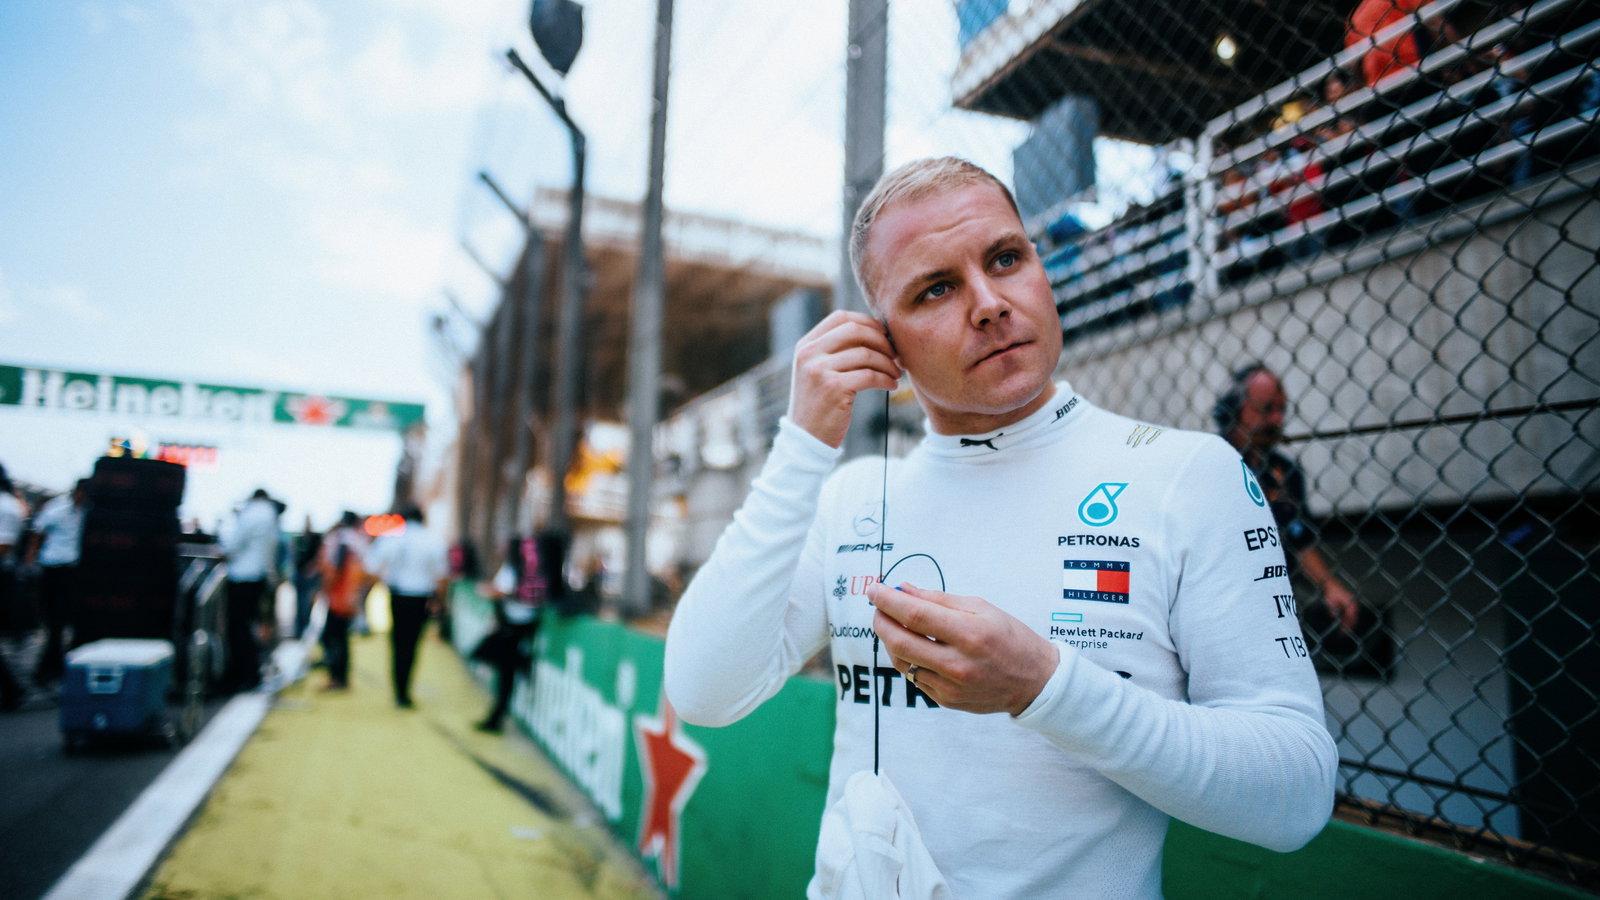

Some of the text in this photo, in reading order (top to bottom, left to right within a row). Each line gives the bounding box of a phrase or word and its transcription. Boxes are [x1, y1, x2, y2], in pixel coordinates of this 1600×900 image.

[1051, 396, 1079, 423] BOSE
[1058, 535, 1140, 548] PETRONAS
[1244, 526, 1280, 551] EPS
[849, 543, 894, 552] AMG
[1069, 561, 1125, 570] TOMMY
[1068, 591, 1124, 602] HILFIGER
[1050, 626, 1143, 640] Hewlett Packard
